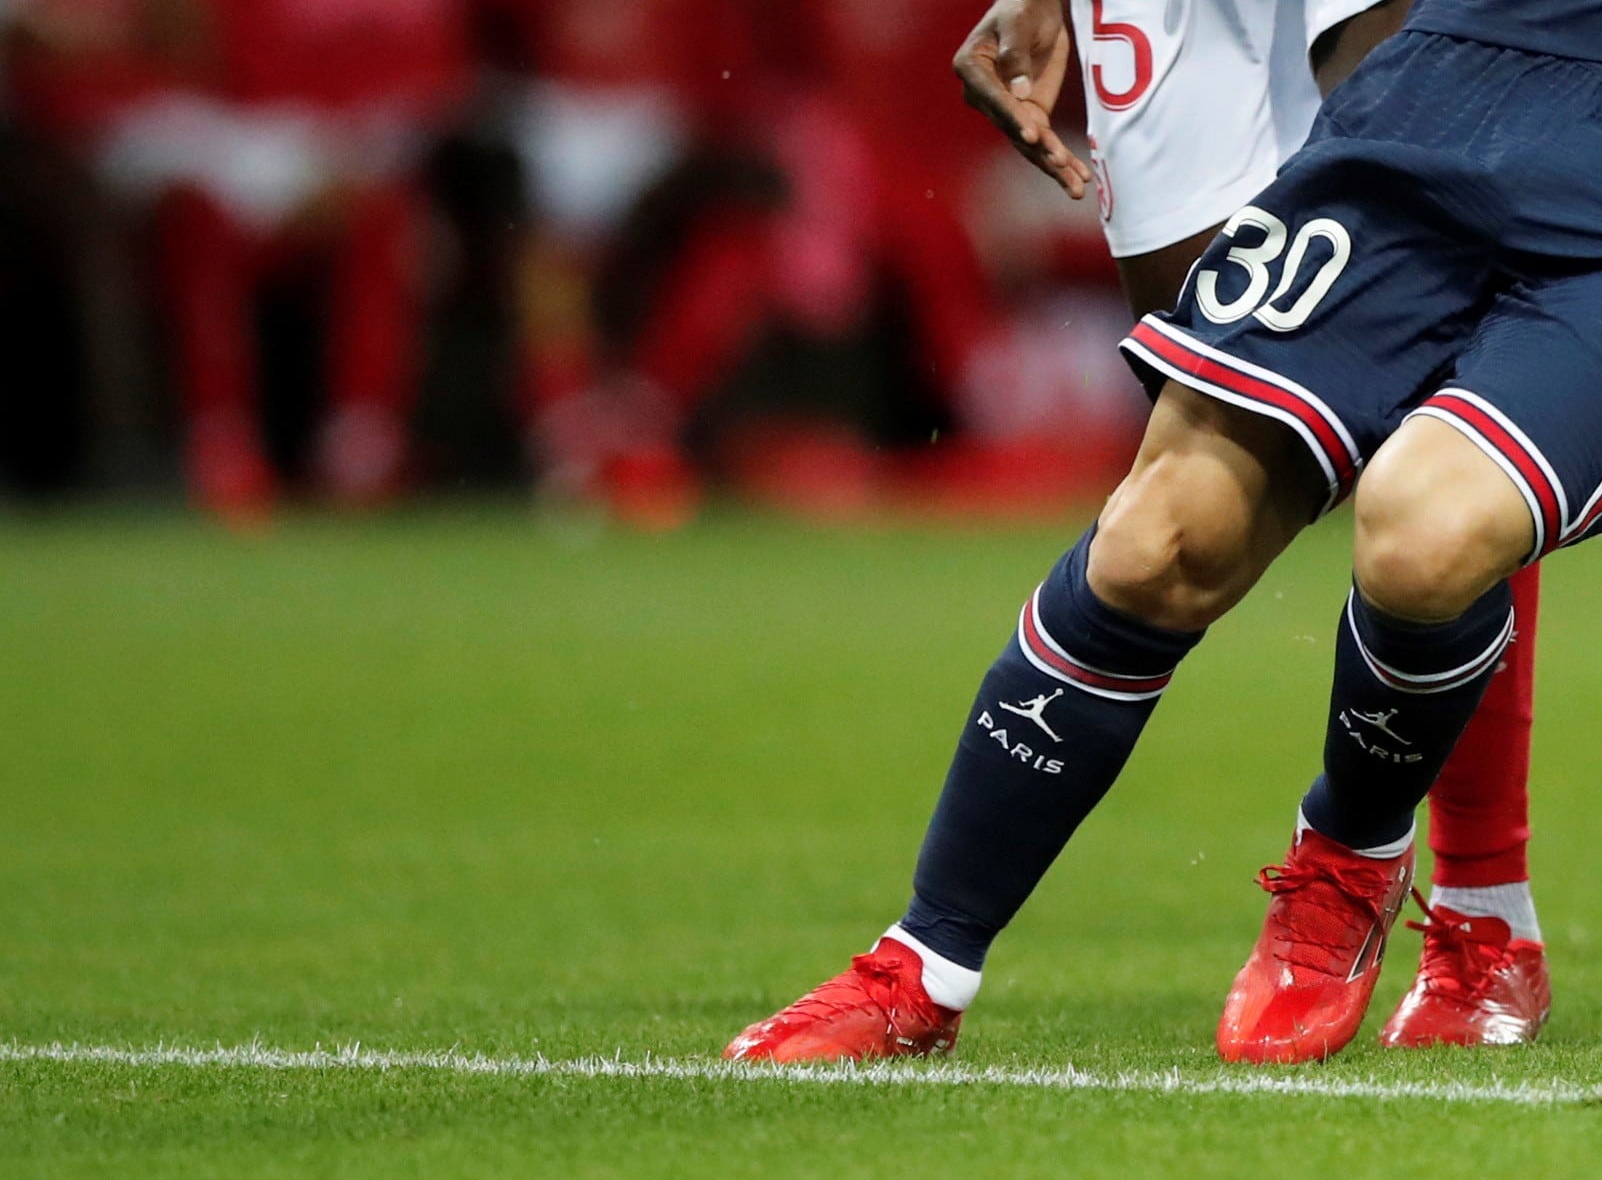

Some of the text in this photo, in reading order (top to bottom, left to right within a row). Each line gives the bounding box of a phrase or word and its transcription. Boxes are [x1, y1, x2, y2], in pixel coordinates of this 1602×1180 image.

[1196, 205, 1352, 332] 30
[977, 710, 1065, 775] PARIS
[1338, 710, 1423, 763] PARIS
